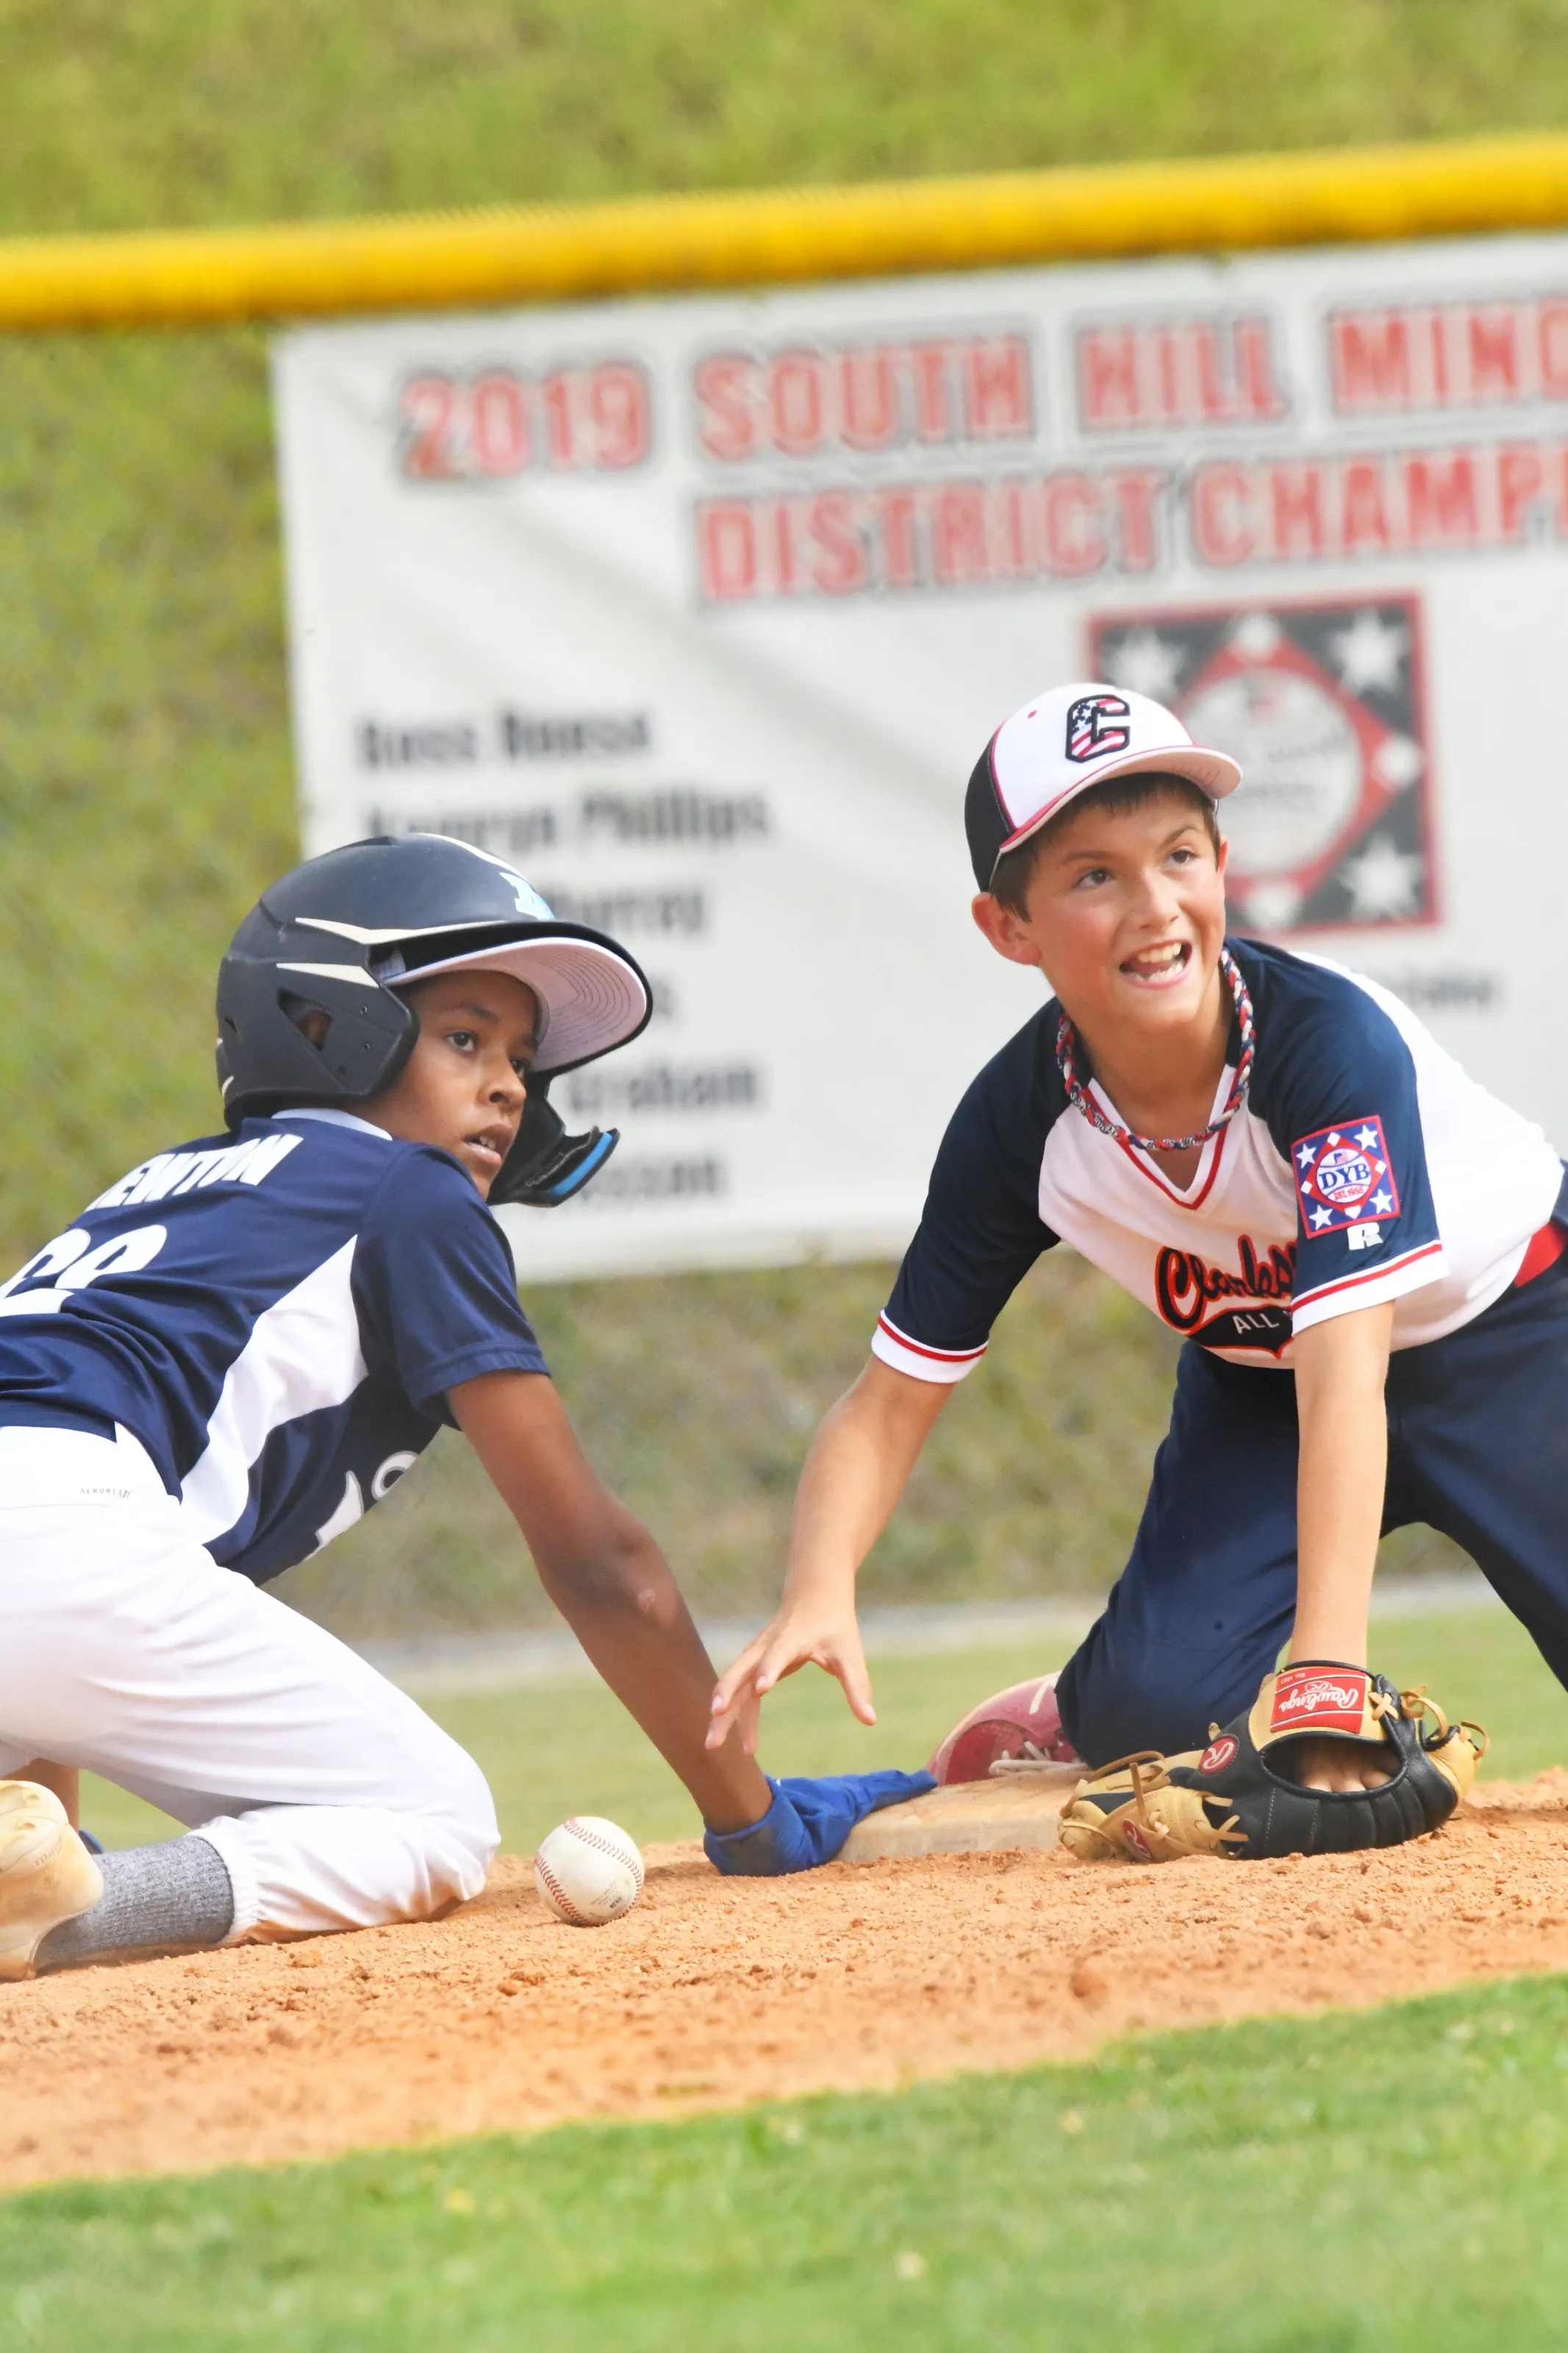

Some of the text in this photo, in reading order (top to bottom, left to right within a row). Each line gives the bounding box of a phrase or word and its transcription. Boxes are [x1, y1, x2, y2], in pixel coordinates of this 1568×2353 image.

[398, 357, 653, 481] 2019
[692, 331, 1035, 463] SOUTH
[1076, 309, 1288, 434] HILL
[695, 465, 1169, 603] DISTRICT
[1065, 694, 1131, 763] C
[83, 1133, 304, 1213] EWTON
[1319, 1163, 1370, 1189] DYB
[1232, 1313, 1280, 1335] ALL
[1278, 1687, 1359, 1713] Rawlings
